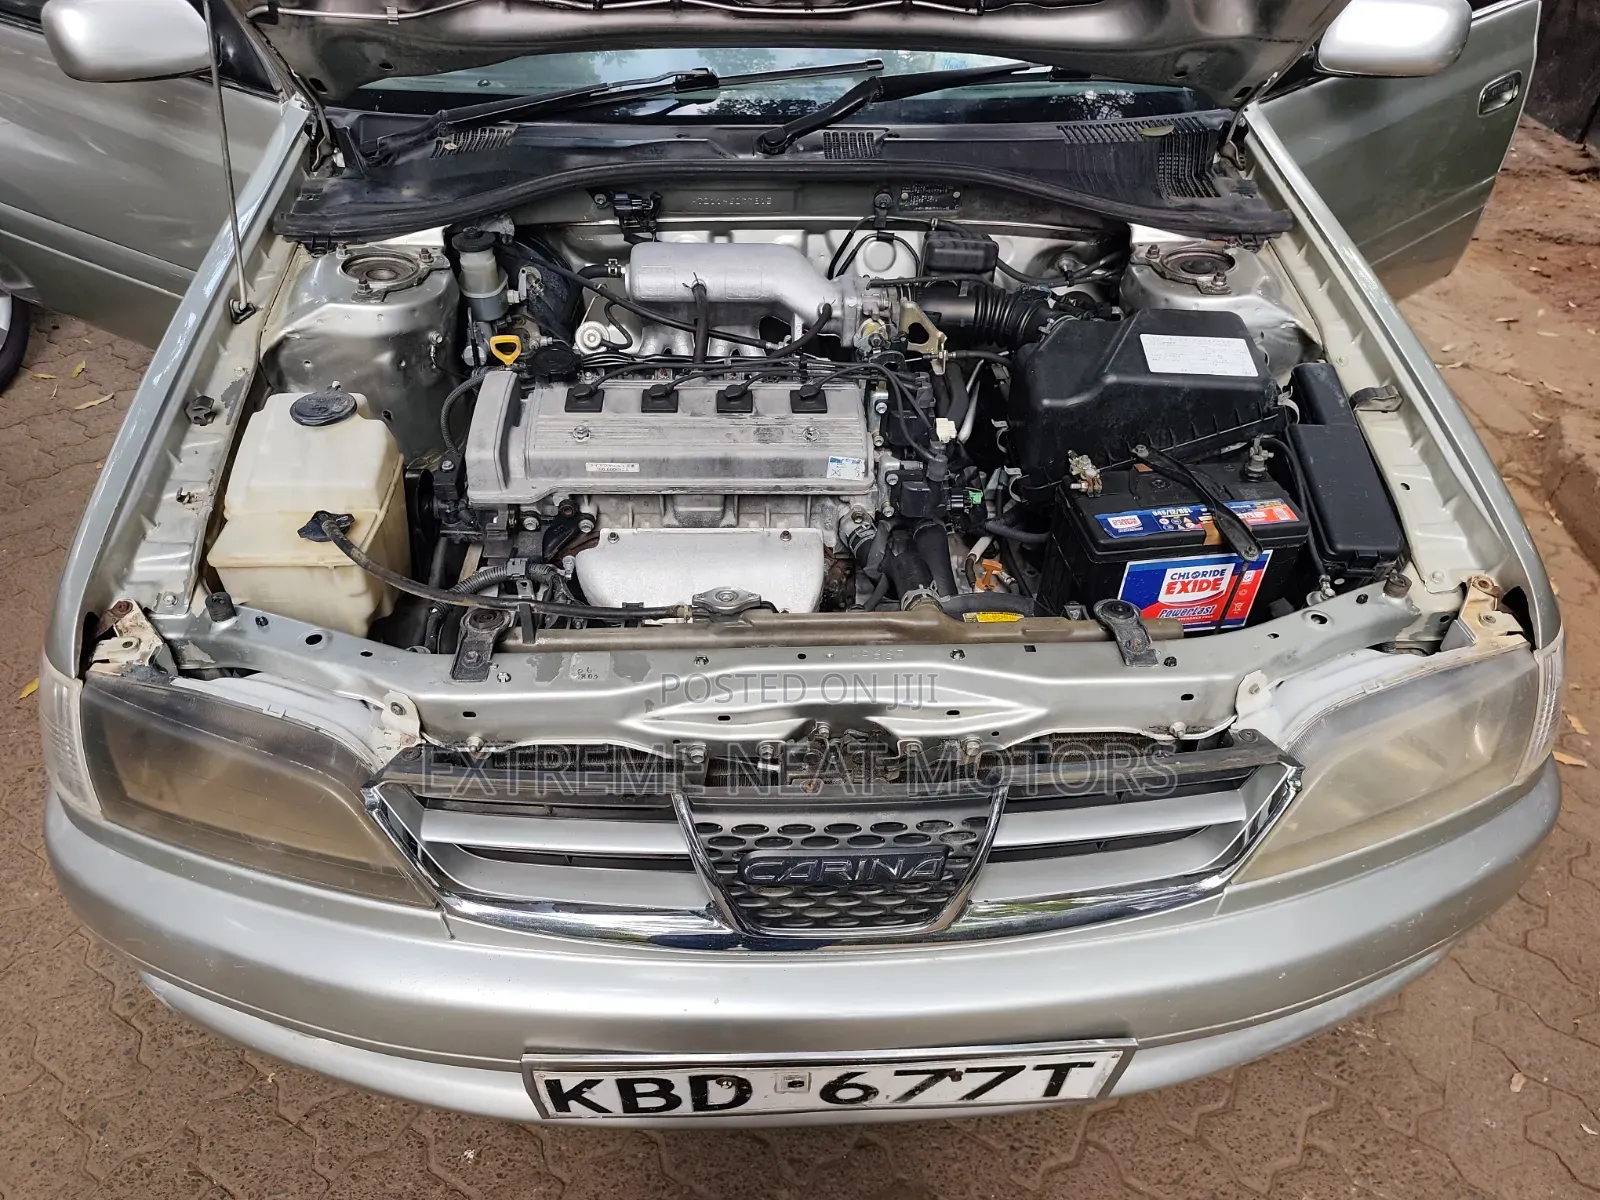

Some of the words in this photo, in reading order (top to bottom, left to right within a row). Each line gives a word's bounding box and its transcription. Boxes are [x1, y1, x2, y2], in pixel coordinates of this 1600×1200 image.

[1170, 568, 1227, 580] CHLORIDE
[1164, 577, 1224, 595] EXIDE
[744, 856, 945, 882] CARINA
[543, 1074, 752, 1115] KBD
[818, 1061, 1096, 1105] 677T
